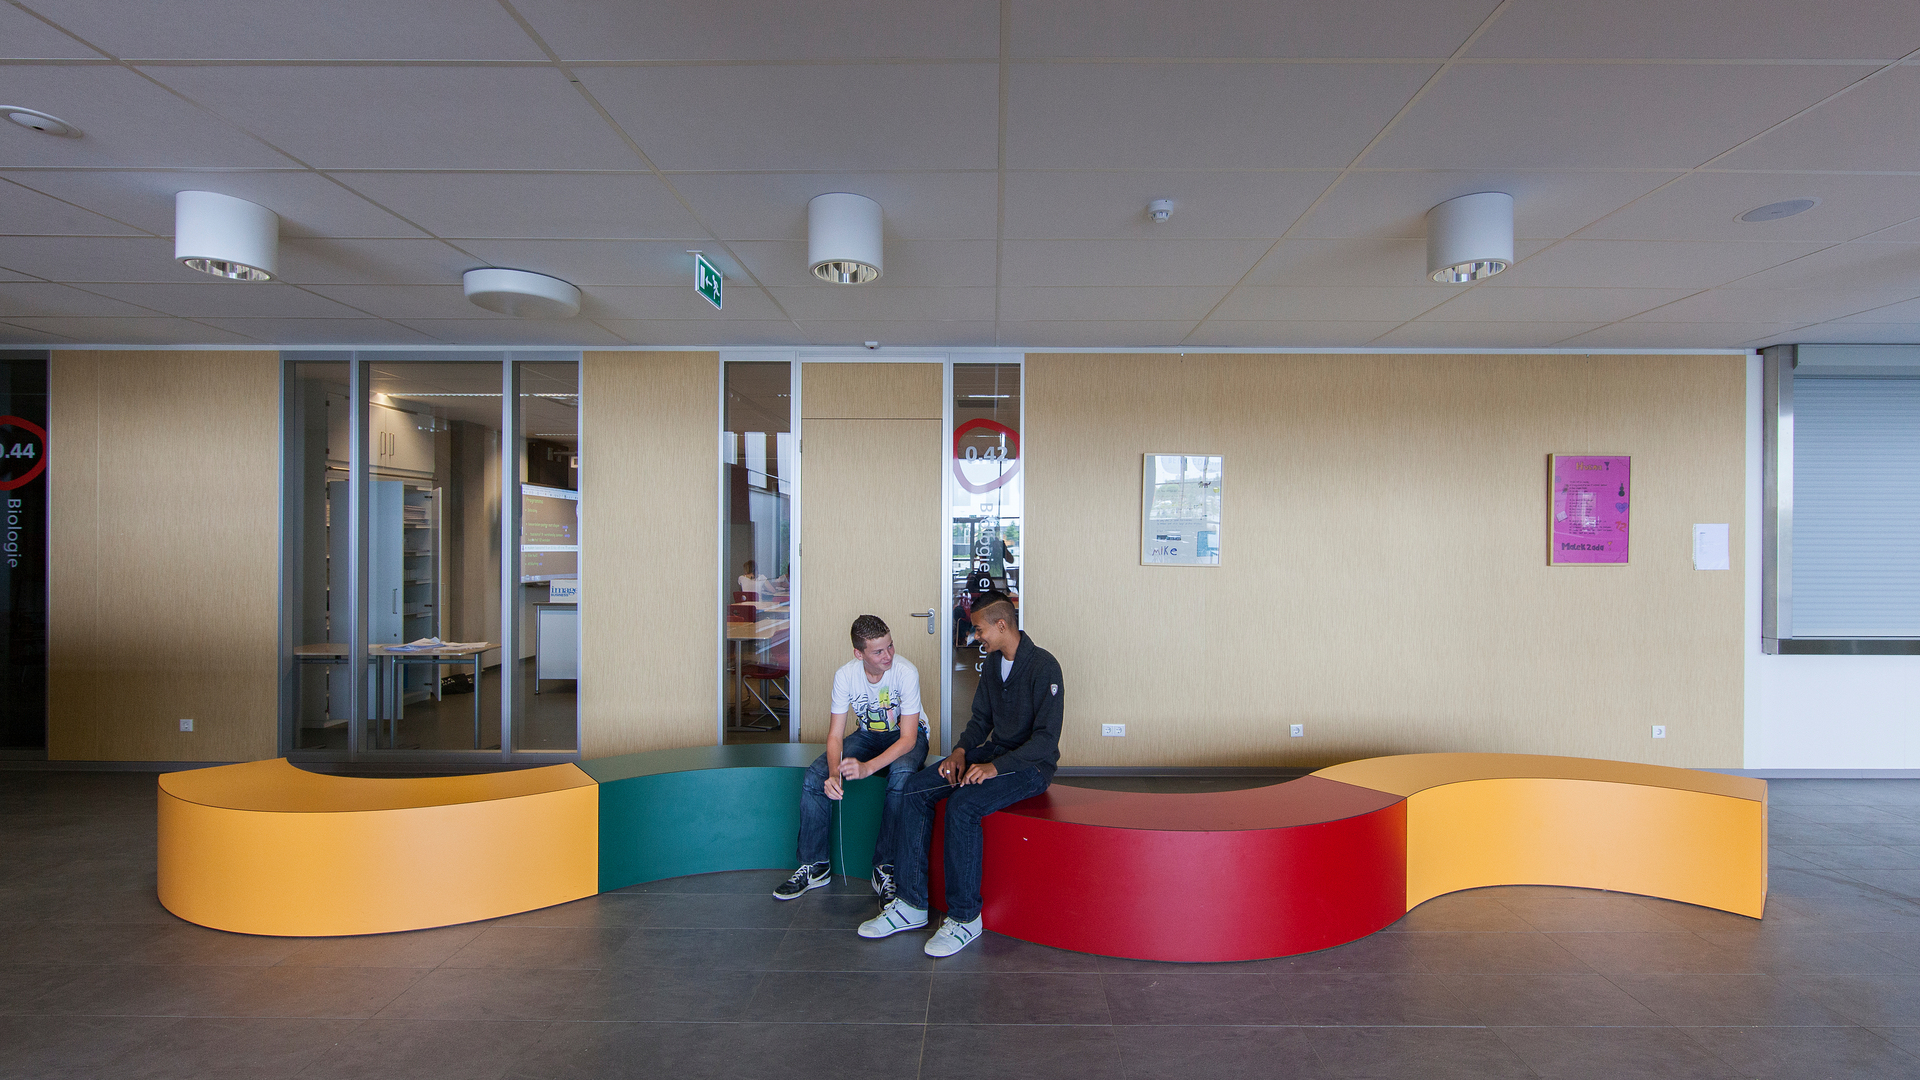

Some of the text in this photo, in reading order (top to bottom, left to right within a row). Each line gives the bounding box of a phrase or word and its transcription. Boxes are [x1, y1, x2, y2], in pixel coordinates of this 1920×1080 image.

[965, 446, 1008, 464] 0.42
[4, 498, 22, 568] Biologie
[976, 503, 994, 573] Biologie
